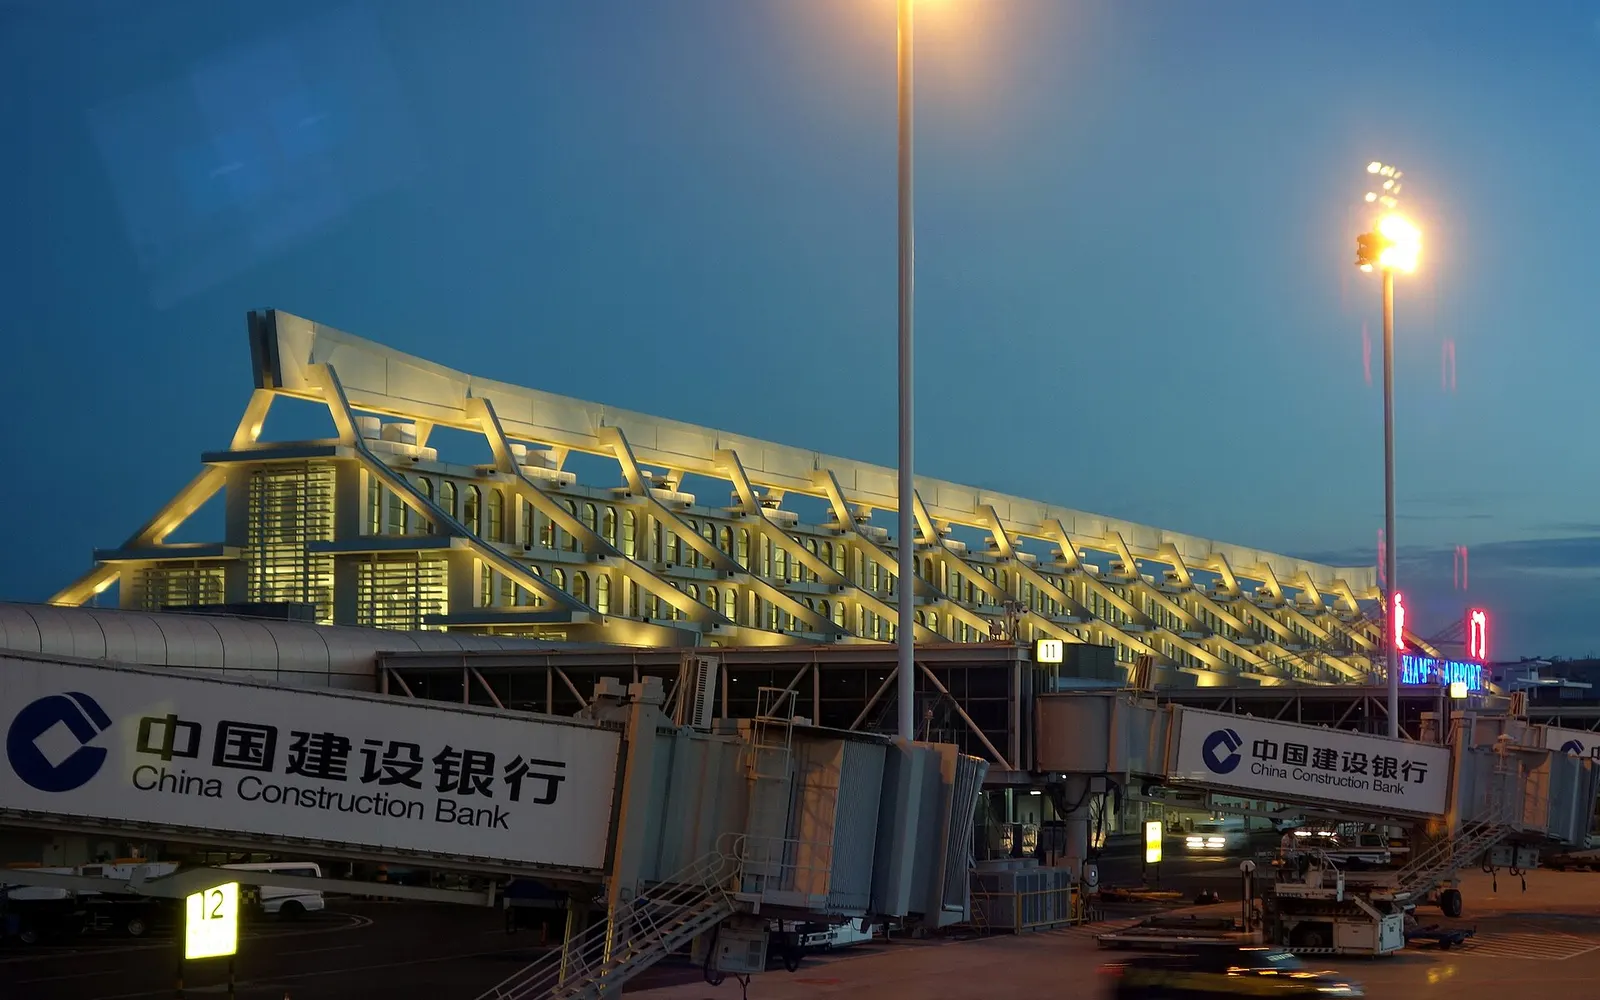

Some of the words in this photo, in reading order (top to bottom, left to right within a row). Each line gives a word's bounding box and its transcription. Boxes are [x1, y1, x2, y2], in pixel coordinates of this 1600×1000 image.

[1045, 644, 1055, 658] 11
[1443, 660, 1482, 691] AIRPORT
[136, 713, 566, 805] 中国建设银行
[1251, 738, 1428, 784] 中国建设银行
[1250, 762, 1288, 779] China
[1292, 767, 1370, 790] Construction
[1372, 779, 1405, 796] Bank
[132, 765, 223, 799] China
[236, 775, 425, 820] Construction
[434, 797, 510, 830] Bank
[200, 888, 224, 920] 12
